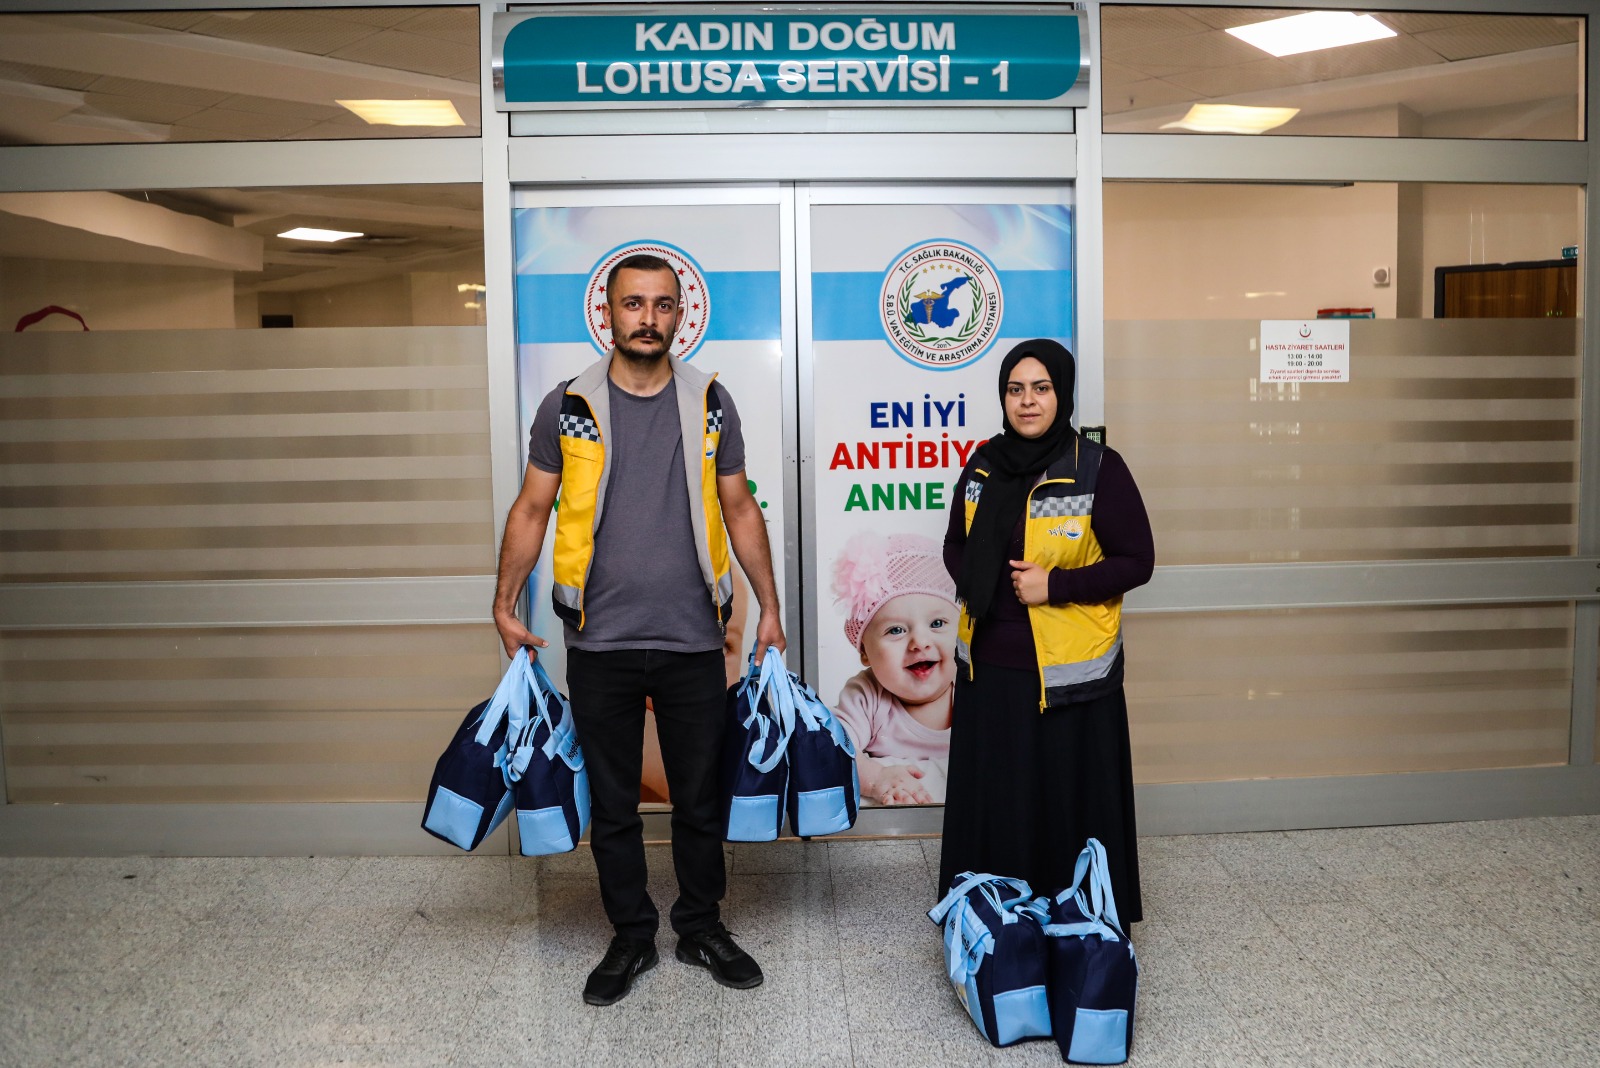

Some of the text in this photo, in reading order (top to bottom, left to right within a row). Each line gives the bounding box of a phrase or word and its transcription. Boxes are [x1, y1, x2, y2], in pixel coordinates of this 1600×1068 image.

[634, 18, 956, 51] KADIN DOĞUM
[576, 61, 765, 94] LOHUSA
[776, 55, 950, 93] SERVİSİ
[991, 61, 1009, 92] 1
[899, 249, 984, 274] T.C. SAĞLIK BAKANLIĞI
[886, 292, 997, 362] S.B.Ü. VAN EĞİTİM VE ARAŞTIRMA HASTANESİ
[1314, 343, 1345, 351] SAATLERİ
[870, 393, 966, 428] EN İYİ
[829, 432, 990, 470] ANTİBİY
[844, 482, 946, 511] ANNE
